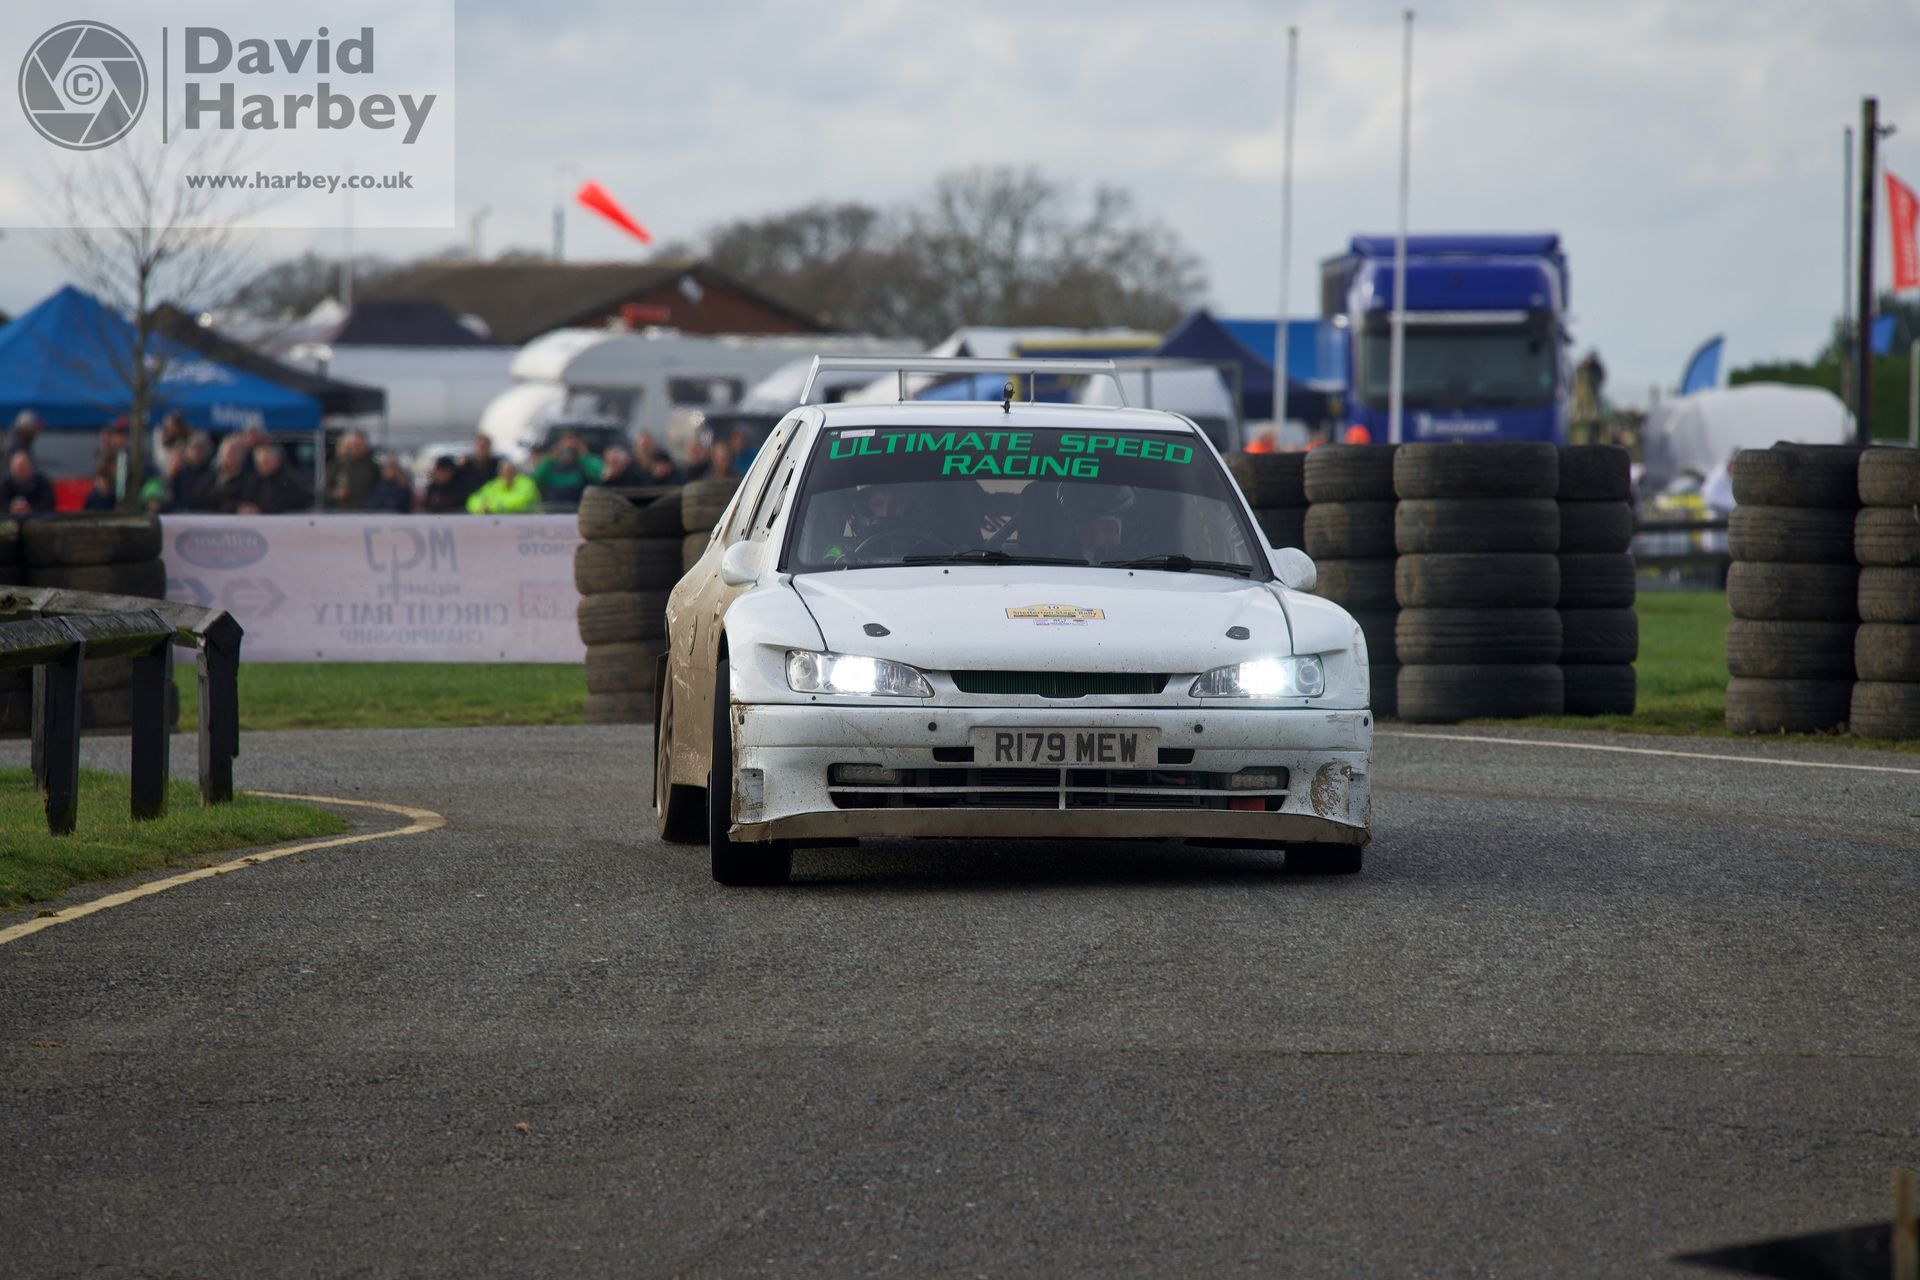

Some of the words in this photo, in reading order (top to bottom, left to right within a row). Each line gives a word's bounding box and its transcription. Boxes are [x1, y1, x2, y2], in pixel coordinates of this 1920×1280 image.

[829, 432, 1035, 461] ULTIMATE
[1059, 434, 1193, 464] SPEED
[941, 455, 1100, 479] RACING
[995, 732, 1066, 762] R179
[1076, 732, 1138, 763] MEW
